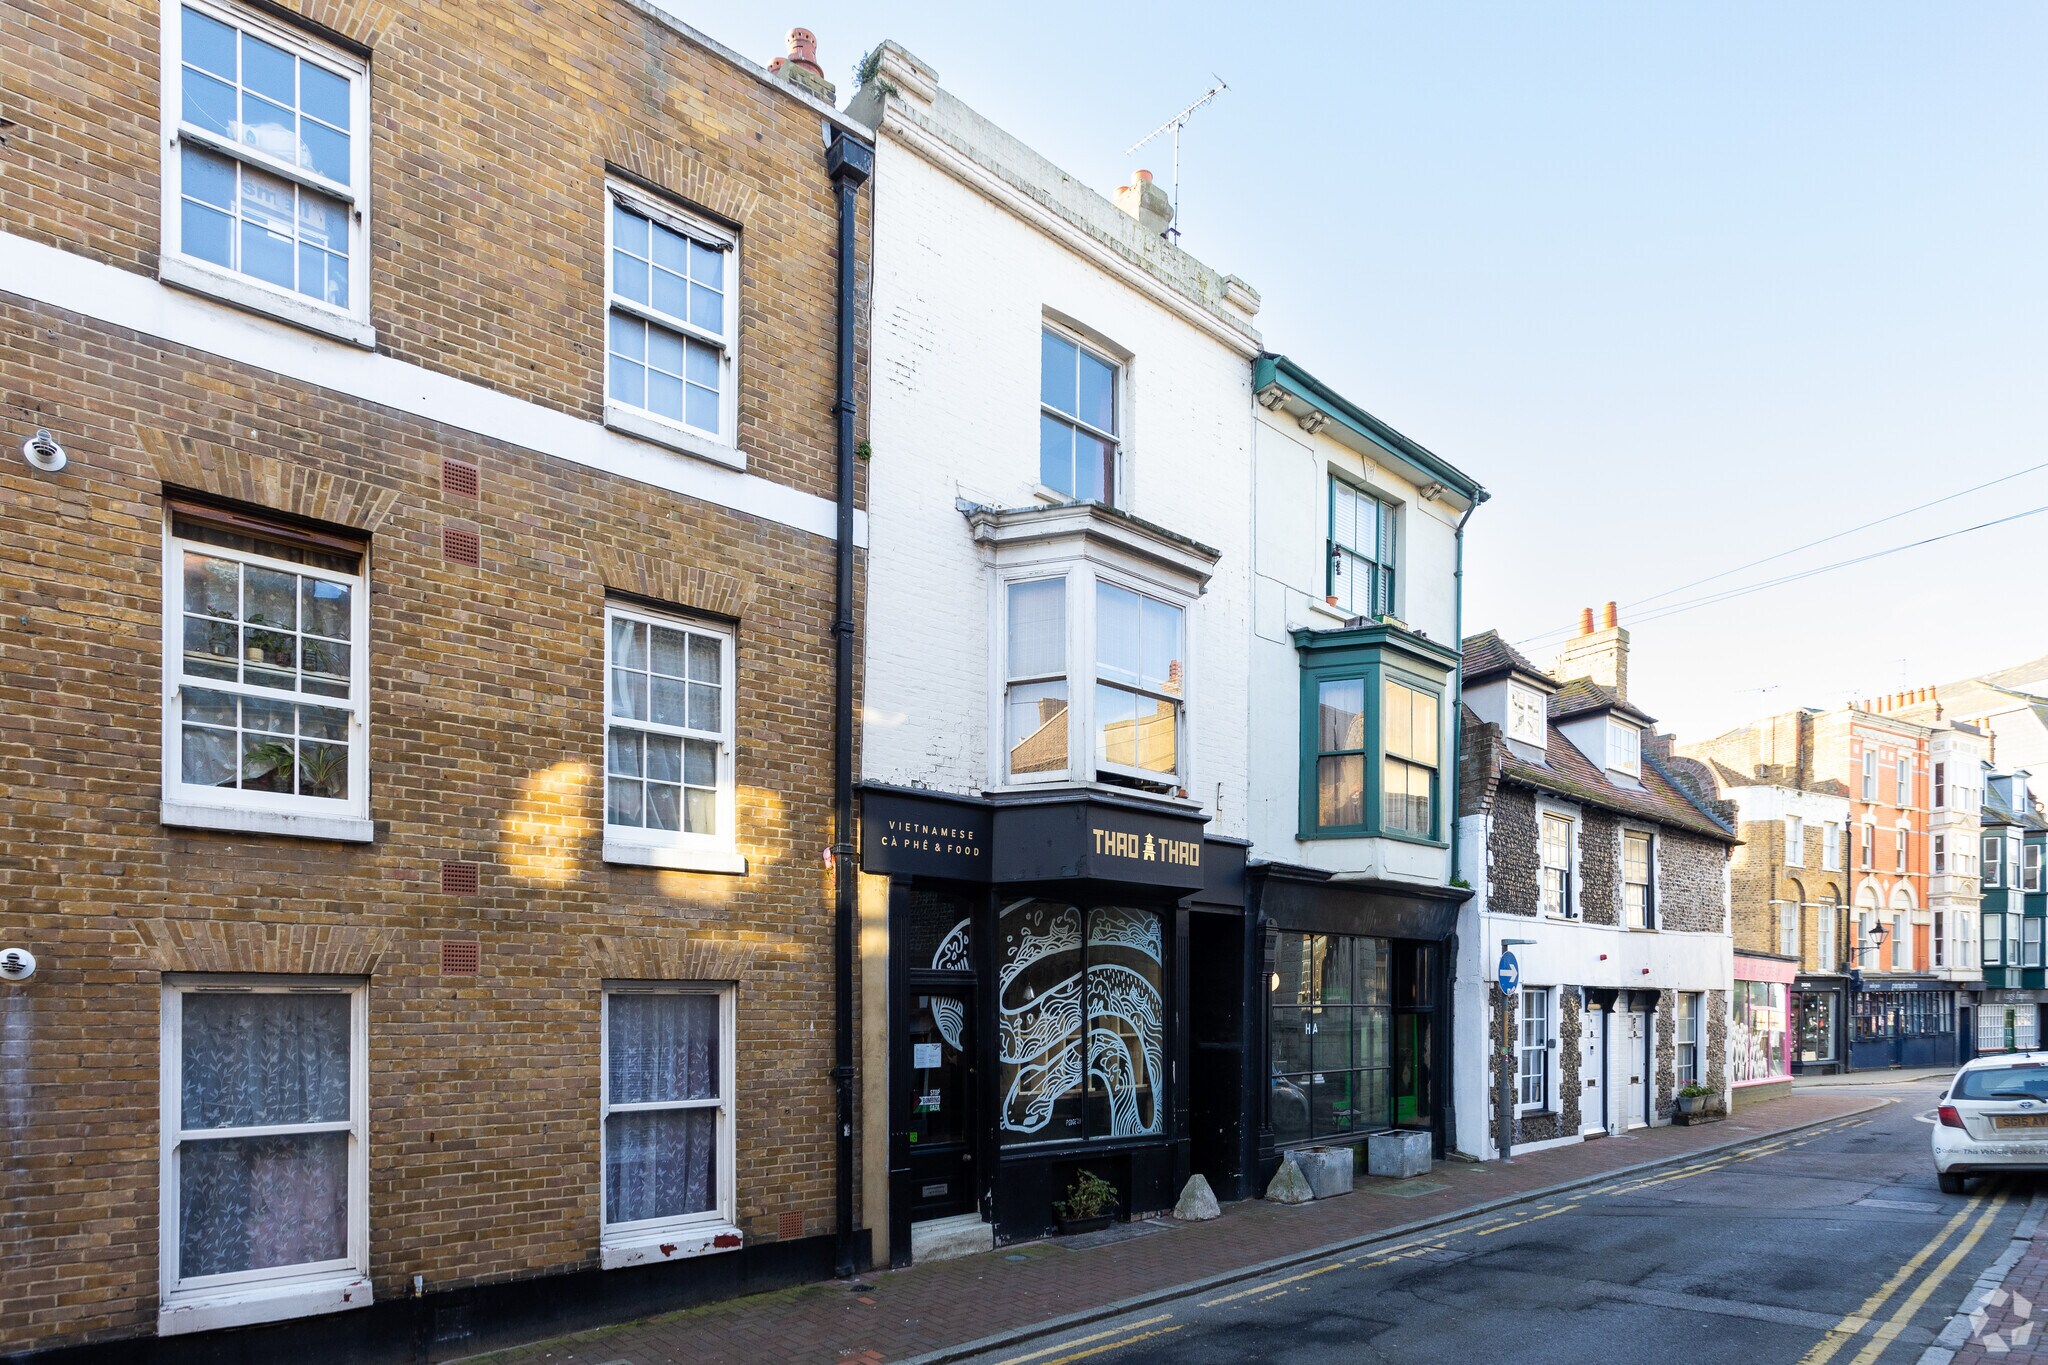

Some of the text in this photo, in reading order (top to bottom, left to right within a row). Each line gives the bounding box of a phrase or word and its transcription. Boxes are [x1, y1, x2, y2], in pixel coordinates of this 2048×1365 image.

[889, 821, 973, 840] VIETNAMESE
[881, 835, 980, 856] CÀ PHÊ & FOOD
[1093, 828, 1200, 867] THAO THAO
[2003, 1117, 2029, 1127] SG15
